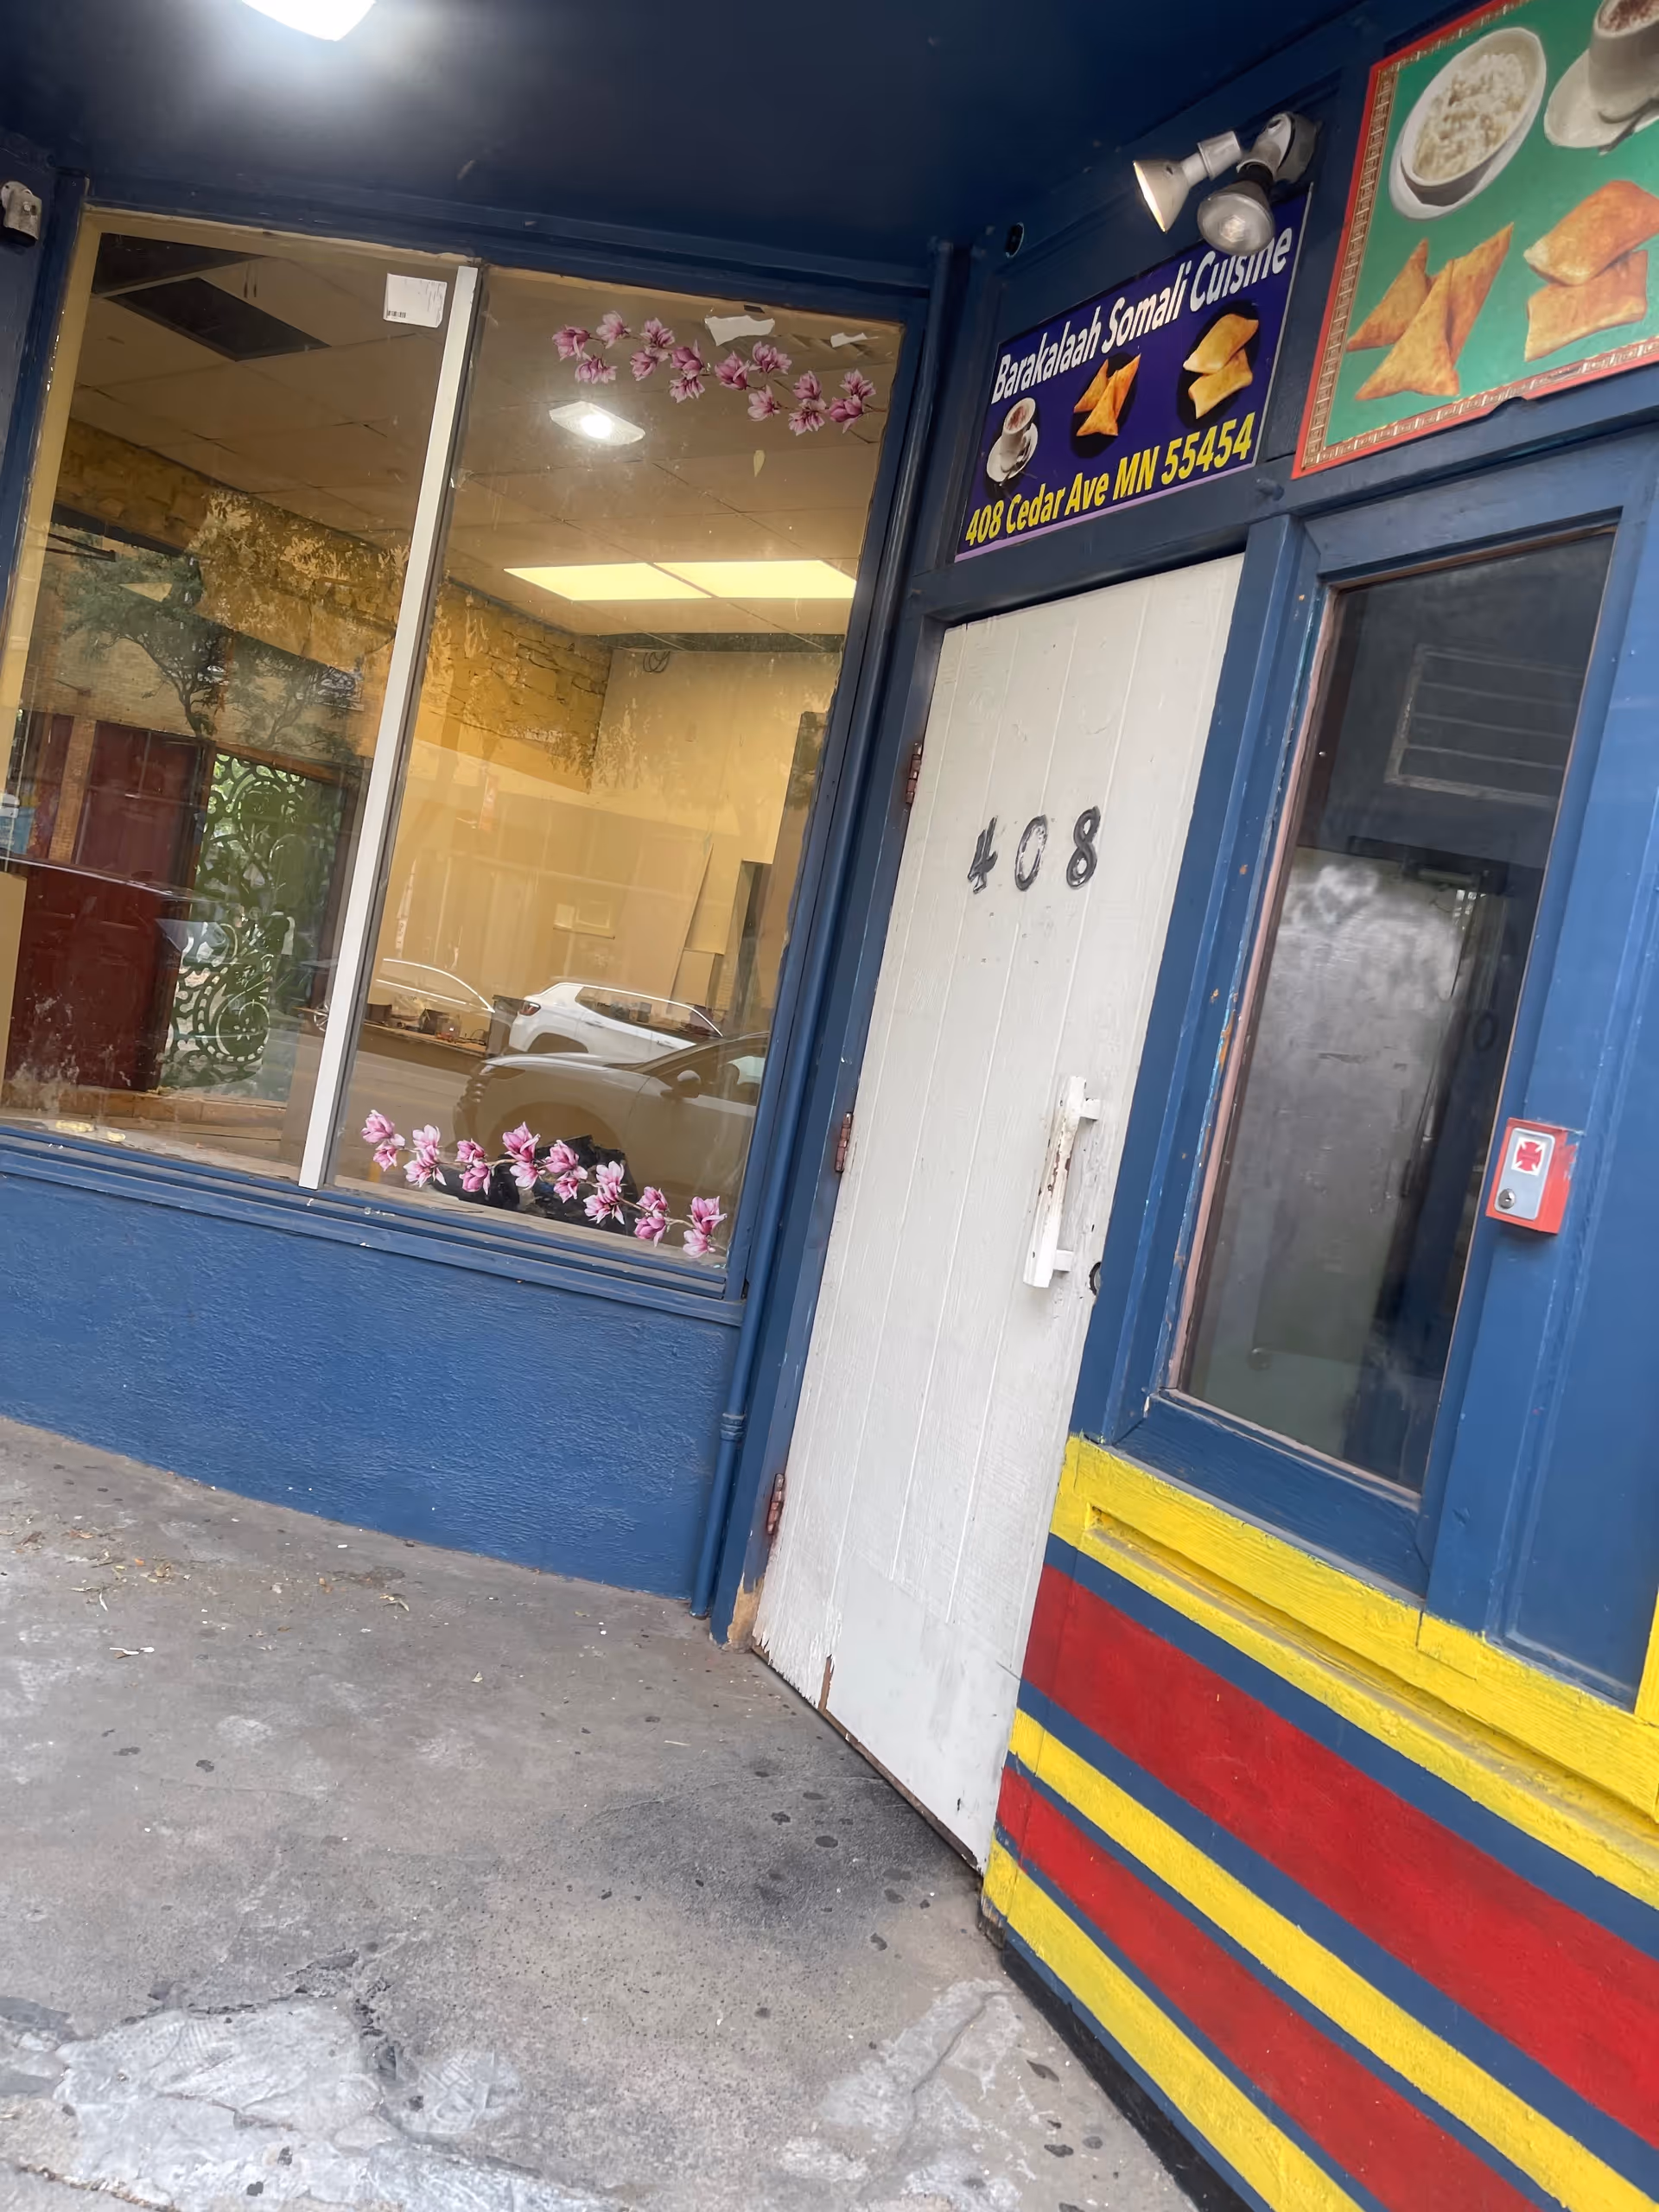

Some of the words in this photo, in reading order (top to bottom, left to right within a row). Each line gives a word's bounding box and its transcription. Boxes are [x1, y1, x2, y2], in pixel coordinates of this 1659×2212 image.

[991, 307, 1101, 404] Barakalaah
[1102, 261, 1192, 353] Somali
[1190, 227, 1293, 312] Cuisine
[965, 500, 1004, 546] 408
[1006, 484, 1065, 534] Cedar
[1065, 473, 1108, 516] Ave
[1112, 444, 1160, 500] MN
[1160, 412, 1255, 485] 55454
[967, 805, 1102, 894] 408
